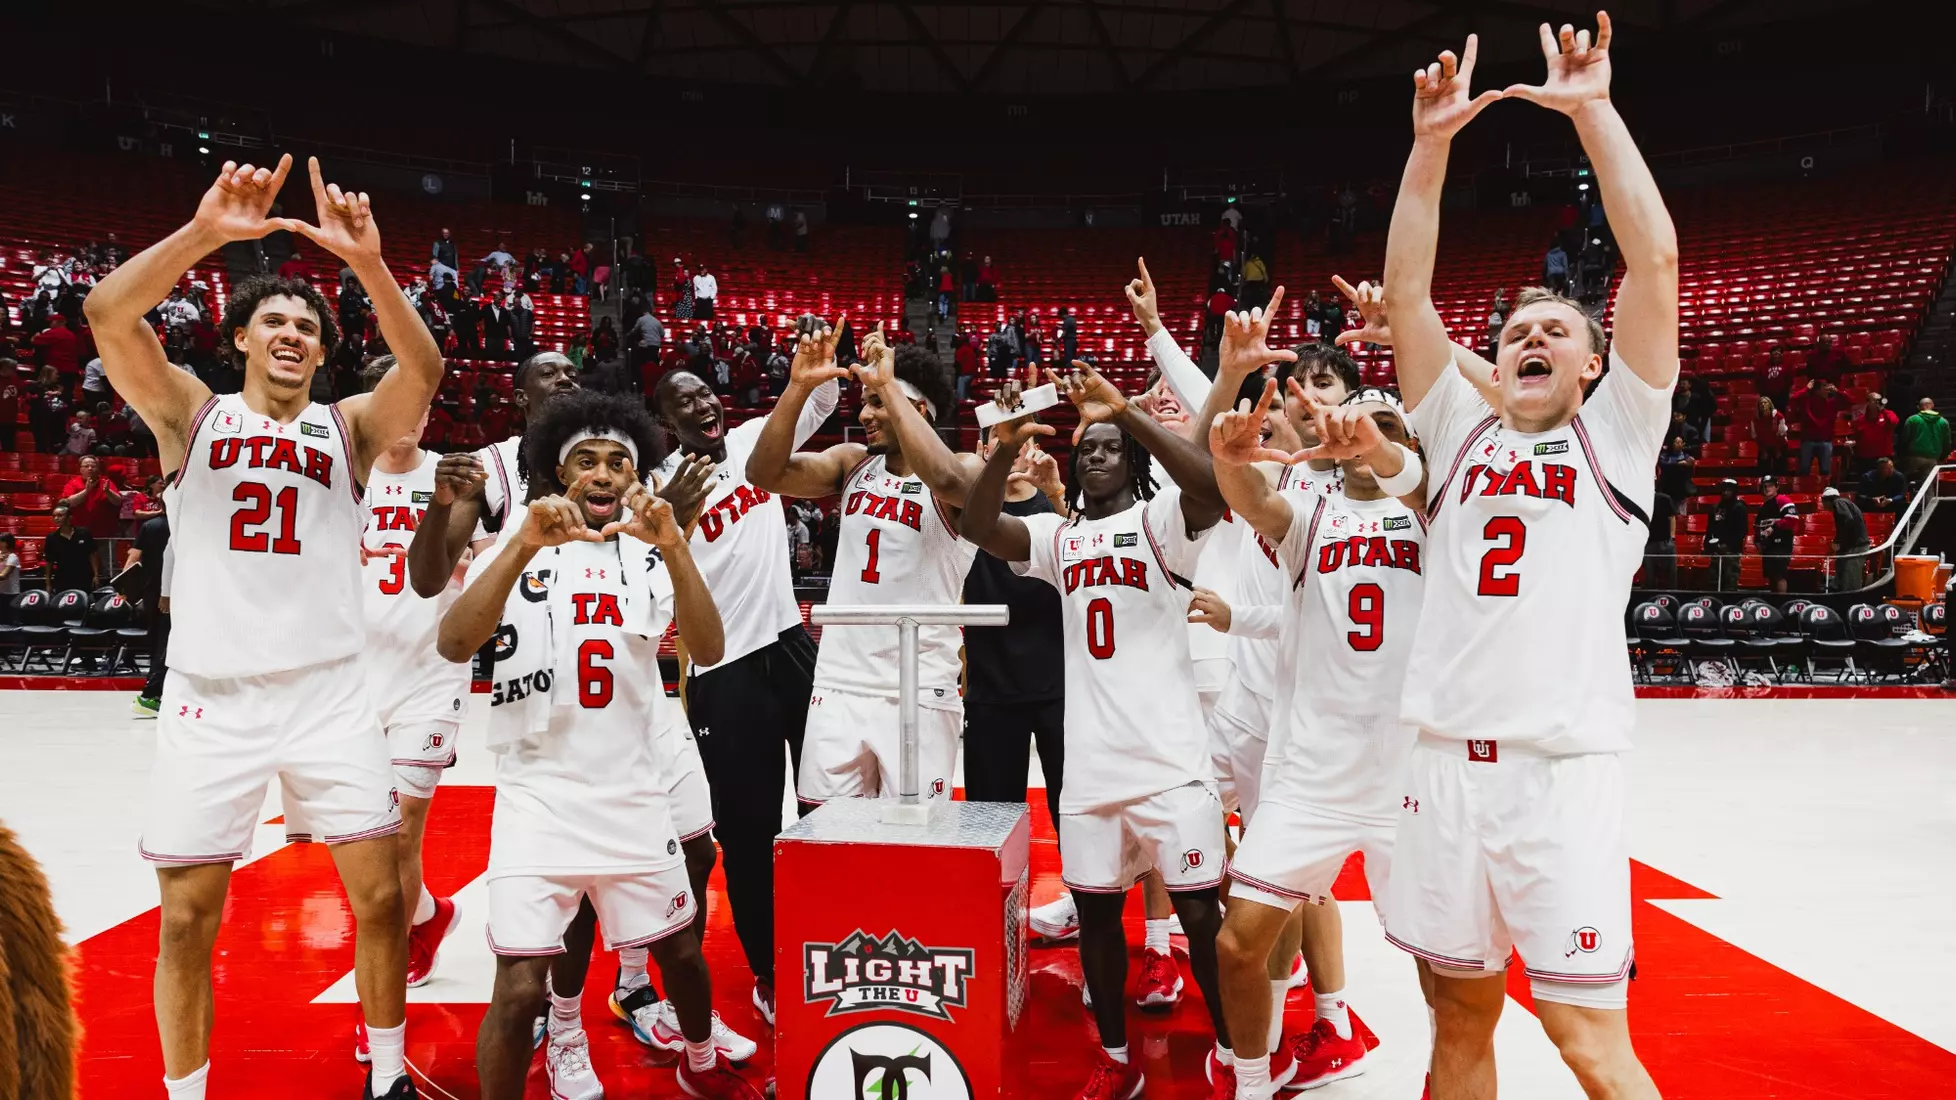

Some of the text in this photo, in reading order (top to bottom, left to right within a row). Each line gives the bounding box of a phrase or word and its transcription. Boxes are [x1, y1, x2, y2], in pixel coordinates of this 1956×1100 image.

[1, 113, 15, 128] K
[117, 134, 174, 158] UH
[1801, 156, 1814, 169] Q
[581, 166, 592, 176] 12
[1160, 212, 1201, 226] UTAH
[209, 435, 334, 490] UTAH
[1460, 460, 1577, 510] UTAH
[229, 481, 302, 555] 21
[372, 505, 427, 532] TA
[844, 490, 923, 533] UTAH
[379, 542, 406, 596] 3
[861, 528, 881, 585] 1
[1063, 556, 1150, 597] UTAH
[1317, 535, 1422, 577] UTAH
[1477, 515, 1527, 597] 2
[1086, 597, 1116, 660] 0
[1347, 583, 1384, 652] 9
[577, 638, 614, 709] 6
[1187, 852, 1201, 866] U
[1579, 932, 1597, 950] U
[810, 949, 967, 1000] LIGHT
[858, 987, 919, 1003] THE U
